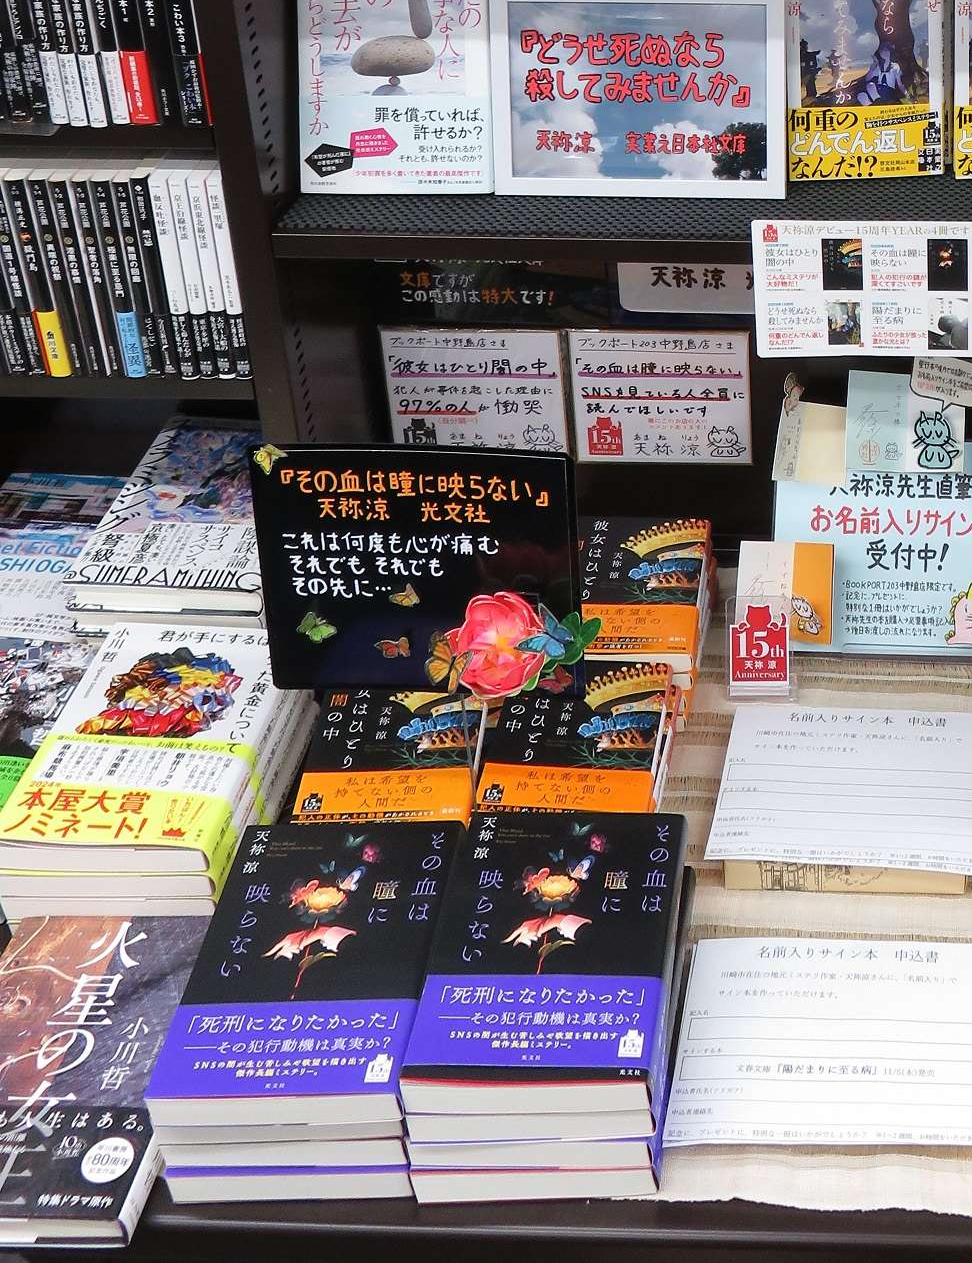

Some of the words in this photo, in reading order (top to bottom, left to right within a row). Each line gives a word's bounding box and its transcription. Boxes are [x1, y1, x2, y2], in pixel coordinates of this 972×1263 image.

[520, 29, 725, 68] 『どうせ死ぬなら
[525, 68, 752, 108] 殺してみませんか』
[374, 106, 486, 124] 罪を償っていれば、
[787, 108, 858, 132] 何重の
[413, 124, 483, 141] 許せるか？
[418, 144, 483, 154] 受け入れられるか？
[790, 129, 916, 156] どんでん返し
[398, 154, 483, 164] それとも、許せないのか？
[765, 248, 819, 258] 彼女はひとり
[870, 249, 927, 258] その血は瞳に
[765, 259, 795, 267] 闇の中
[870, 259, 907, 267] 映らない
[399, 271, 475, 288] 文庫ですが
[401, 288, 556, 307] この感動は特大です！
[767, 306, 818, 316] どうせ死ぬなら
[768, 316, 824, 325] 殺してみませんか
[871, 306, 922, 316] 陽だまりに
[871, 316, 904, 325] 至る病
[388, 355, 558, 377] 「彼女はひとり闇の中」
[575, 358, 742, 377] 「その血は瞳に映らない」
[394, 385, 553, 397] 犯人が事件を起こした理由に
[581, 387, 745, 400] SNSを見ている人全員に
[586, 402, 708, 416] 読んでほしいです
[281, 468, 550, 507] 『その血は瞳に映らない』
[420, 501, 491, 524] 光文社
[282, 531, 499, 556] これは何度も心が痛む
[581, 519, 610, 601] 彼女はひとり
[866, 538, 949, 573] 受付中！
[289, 554, 366, 575] それでも
[374, 556, 444, 577] それでも
[101, 627, 130, 663] 小川哲
[735, 630, 785, 659] 15th
[734, 670, 785, 682] Anniversary
[788, 712, 894, 727] 名前入りサイン本
[907, 717, 948, 729] 申込書
[345, 775, 428, 786] 私は希望を
[526, 772, 608, 784] 私は希望を
[333, 786, 433, 798] 持てない側の
[515, 784, 611, 796] 持てない側の
[16, 789, 151, 815] 本屋大賞
[357, 796, 408, 808] 人間だ
[536, 795, 586, 806] 人間だ
[3, 815, 149, 840] ノミネート！
[241, 829, 272, 875] 天祢涼
[407, 831, 445, 922] その血は
[640, 824, 670, 914] その血は
[601, 870, 629, 914] 瞳に
[366, 881, 400, 924] 瞳に
[461, 869, 503, 963] 映らない
[219, 884, 272, 978] 映らない
[758, 945, 878, 962] 名前入りサイン本
[894, 947, 940, 964] 申込書
[438, 985, 647, 1007] 「死刑になりたかった」
[185, 1011, 400, 1037] 「死刑になりたかった」
[99, 1016, 149, 1091] 小川哲
[775, 1062, 877, 1077] 『陽だまりに至る病』
